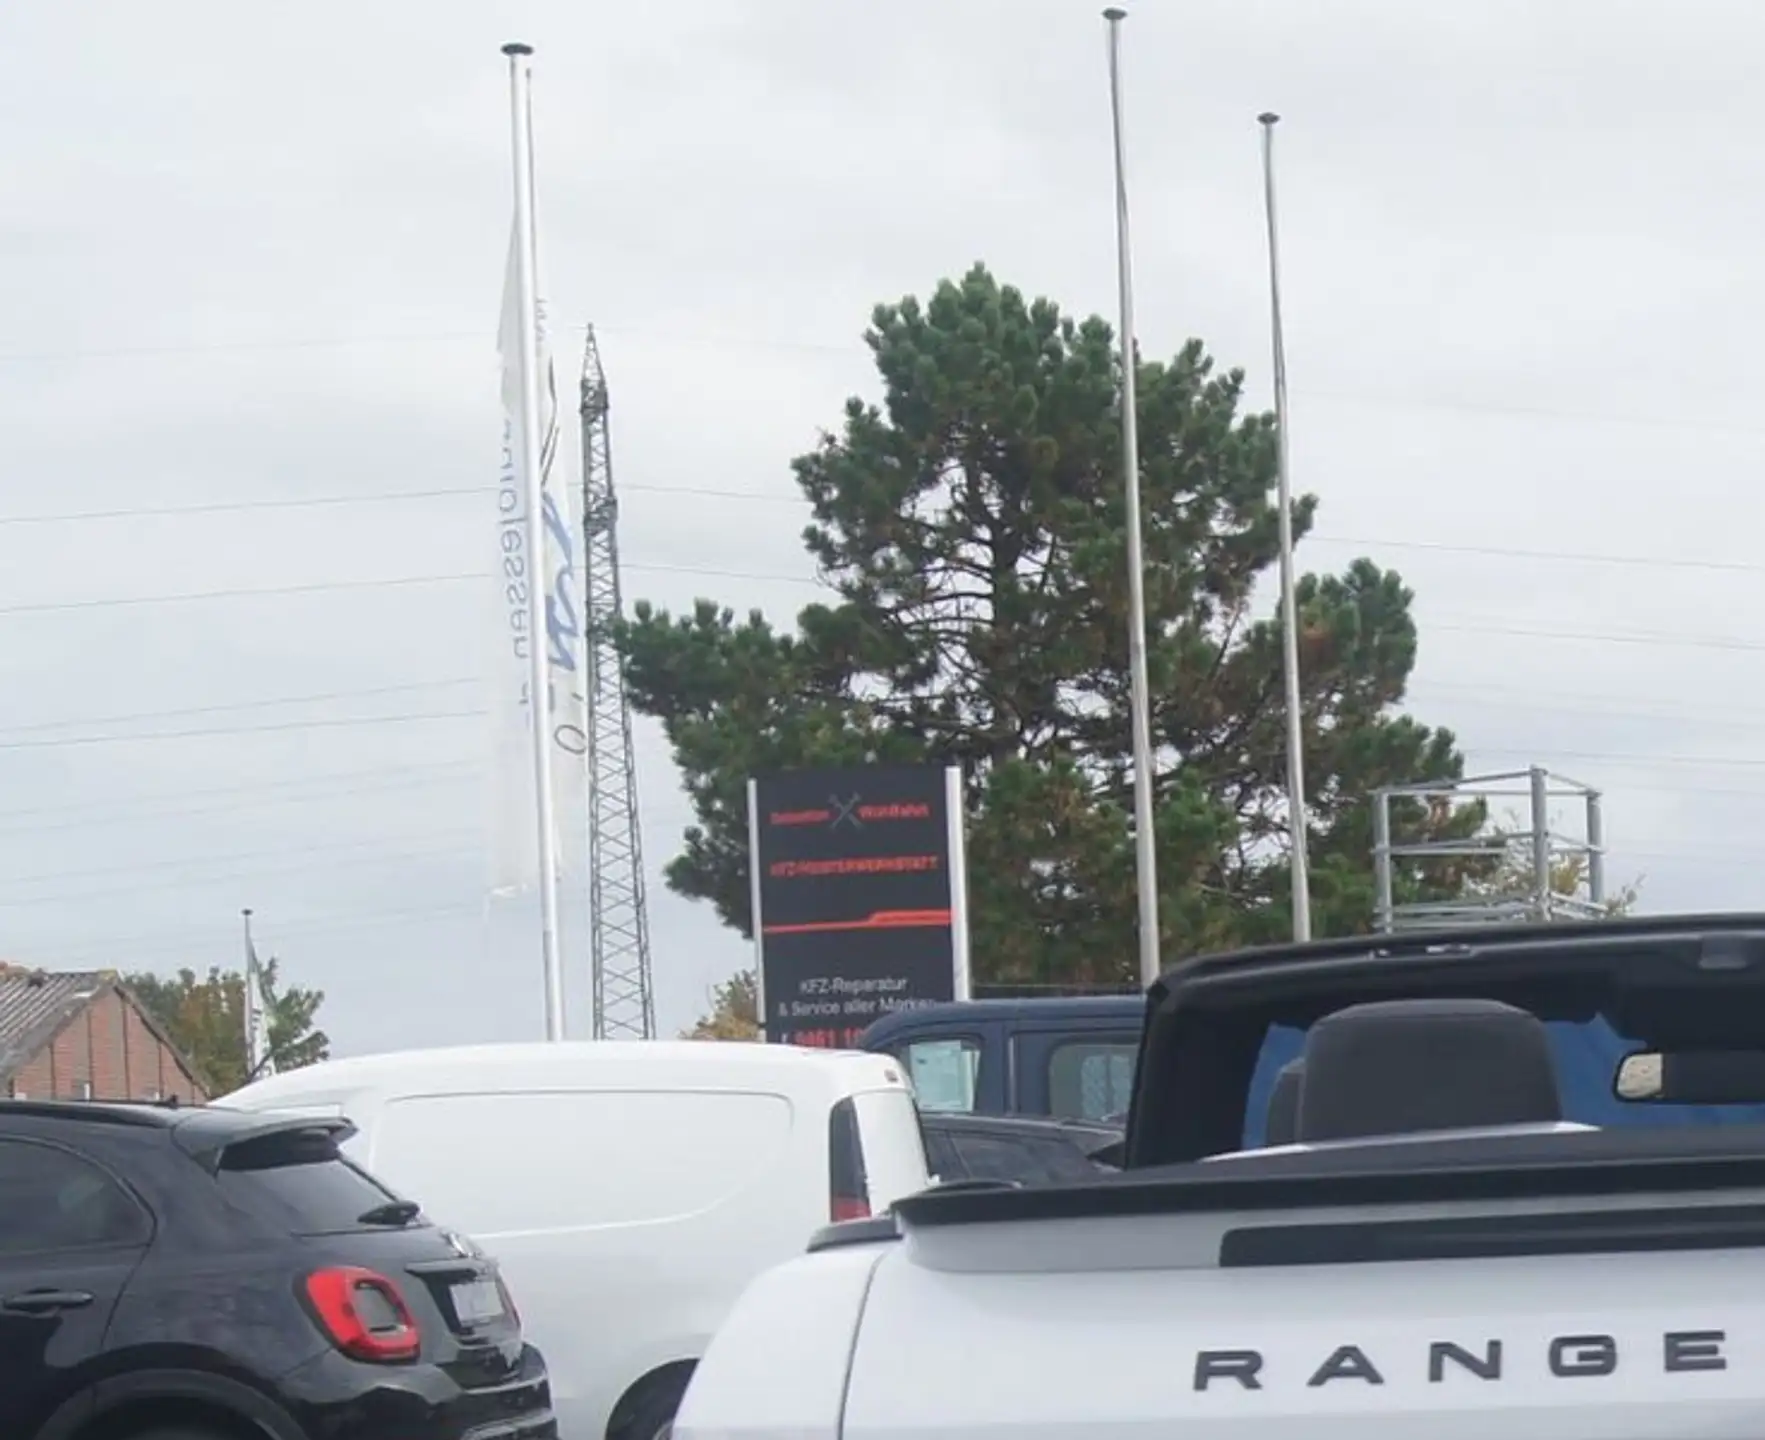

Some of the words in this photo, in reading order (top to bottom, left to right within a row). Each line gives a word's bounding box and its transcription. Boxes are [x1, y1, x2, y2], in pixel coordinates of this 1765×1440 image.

[792, 1000, 840, 1016] Service
[844, 999, 875, 1013] aller
[1193, 1329, 1727, 1391] RANGE
